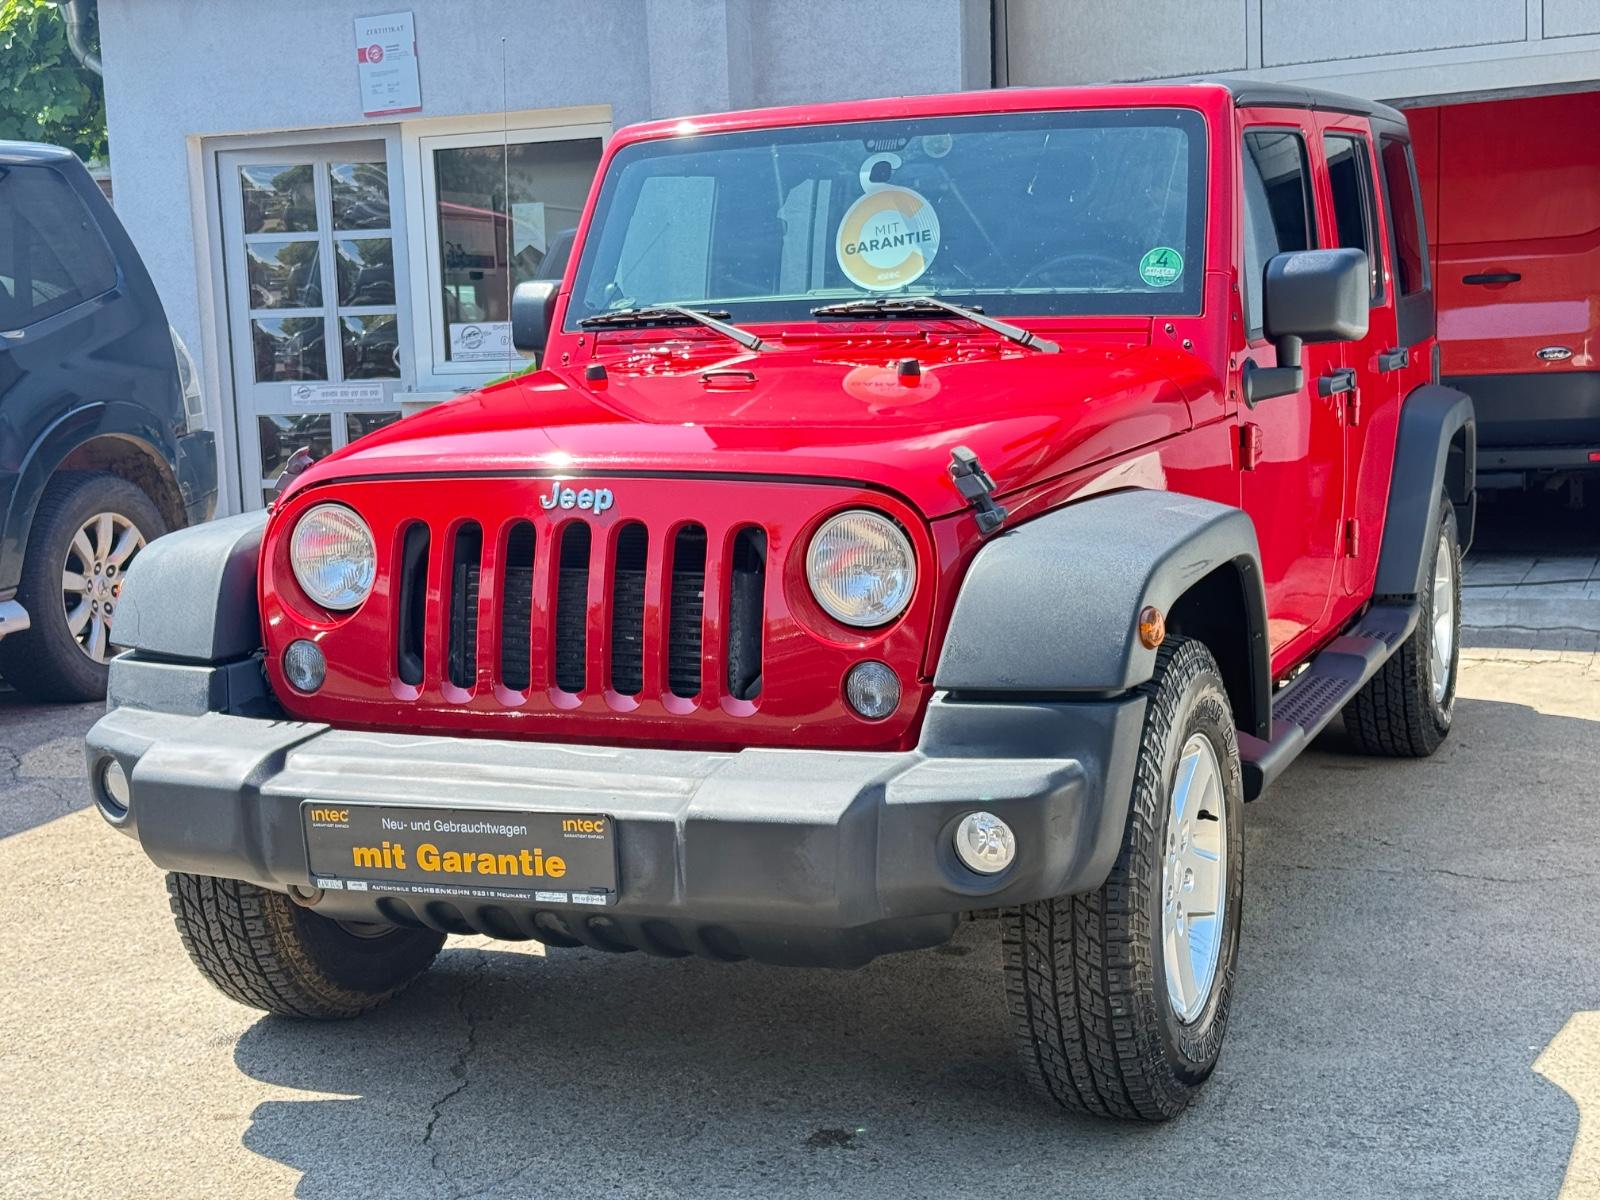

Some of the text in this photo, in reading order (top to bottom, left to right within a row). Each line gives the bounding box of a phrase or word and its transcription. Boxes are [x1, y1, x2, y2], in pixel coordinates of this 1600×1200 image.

[366, 24, 405, 36] ZERTIFIKAT
[875, 222, 900, 237] MIT
[845, 229, 932, 256] GARANTIE
[1156, 250, 1169, 267] 4
[539, 481, 615, 516] Jeep
[311, 809, 349, 822] intec
[382, 817, 528, 838] Neu- und Gebrauchtwagen
[562, 818, 605, 833] intec
[352, 841, 567, 878] mit Garantie
